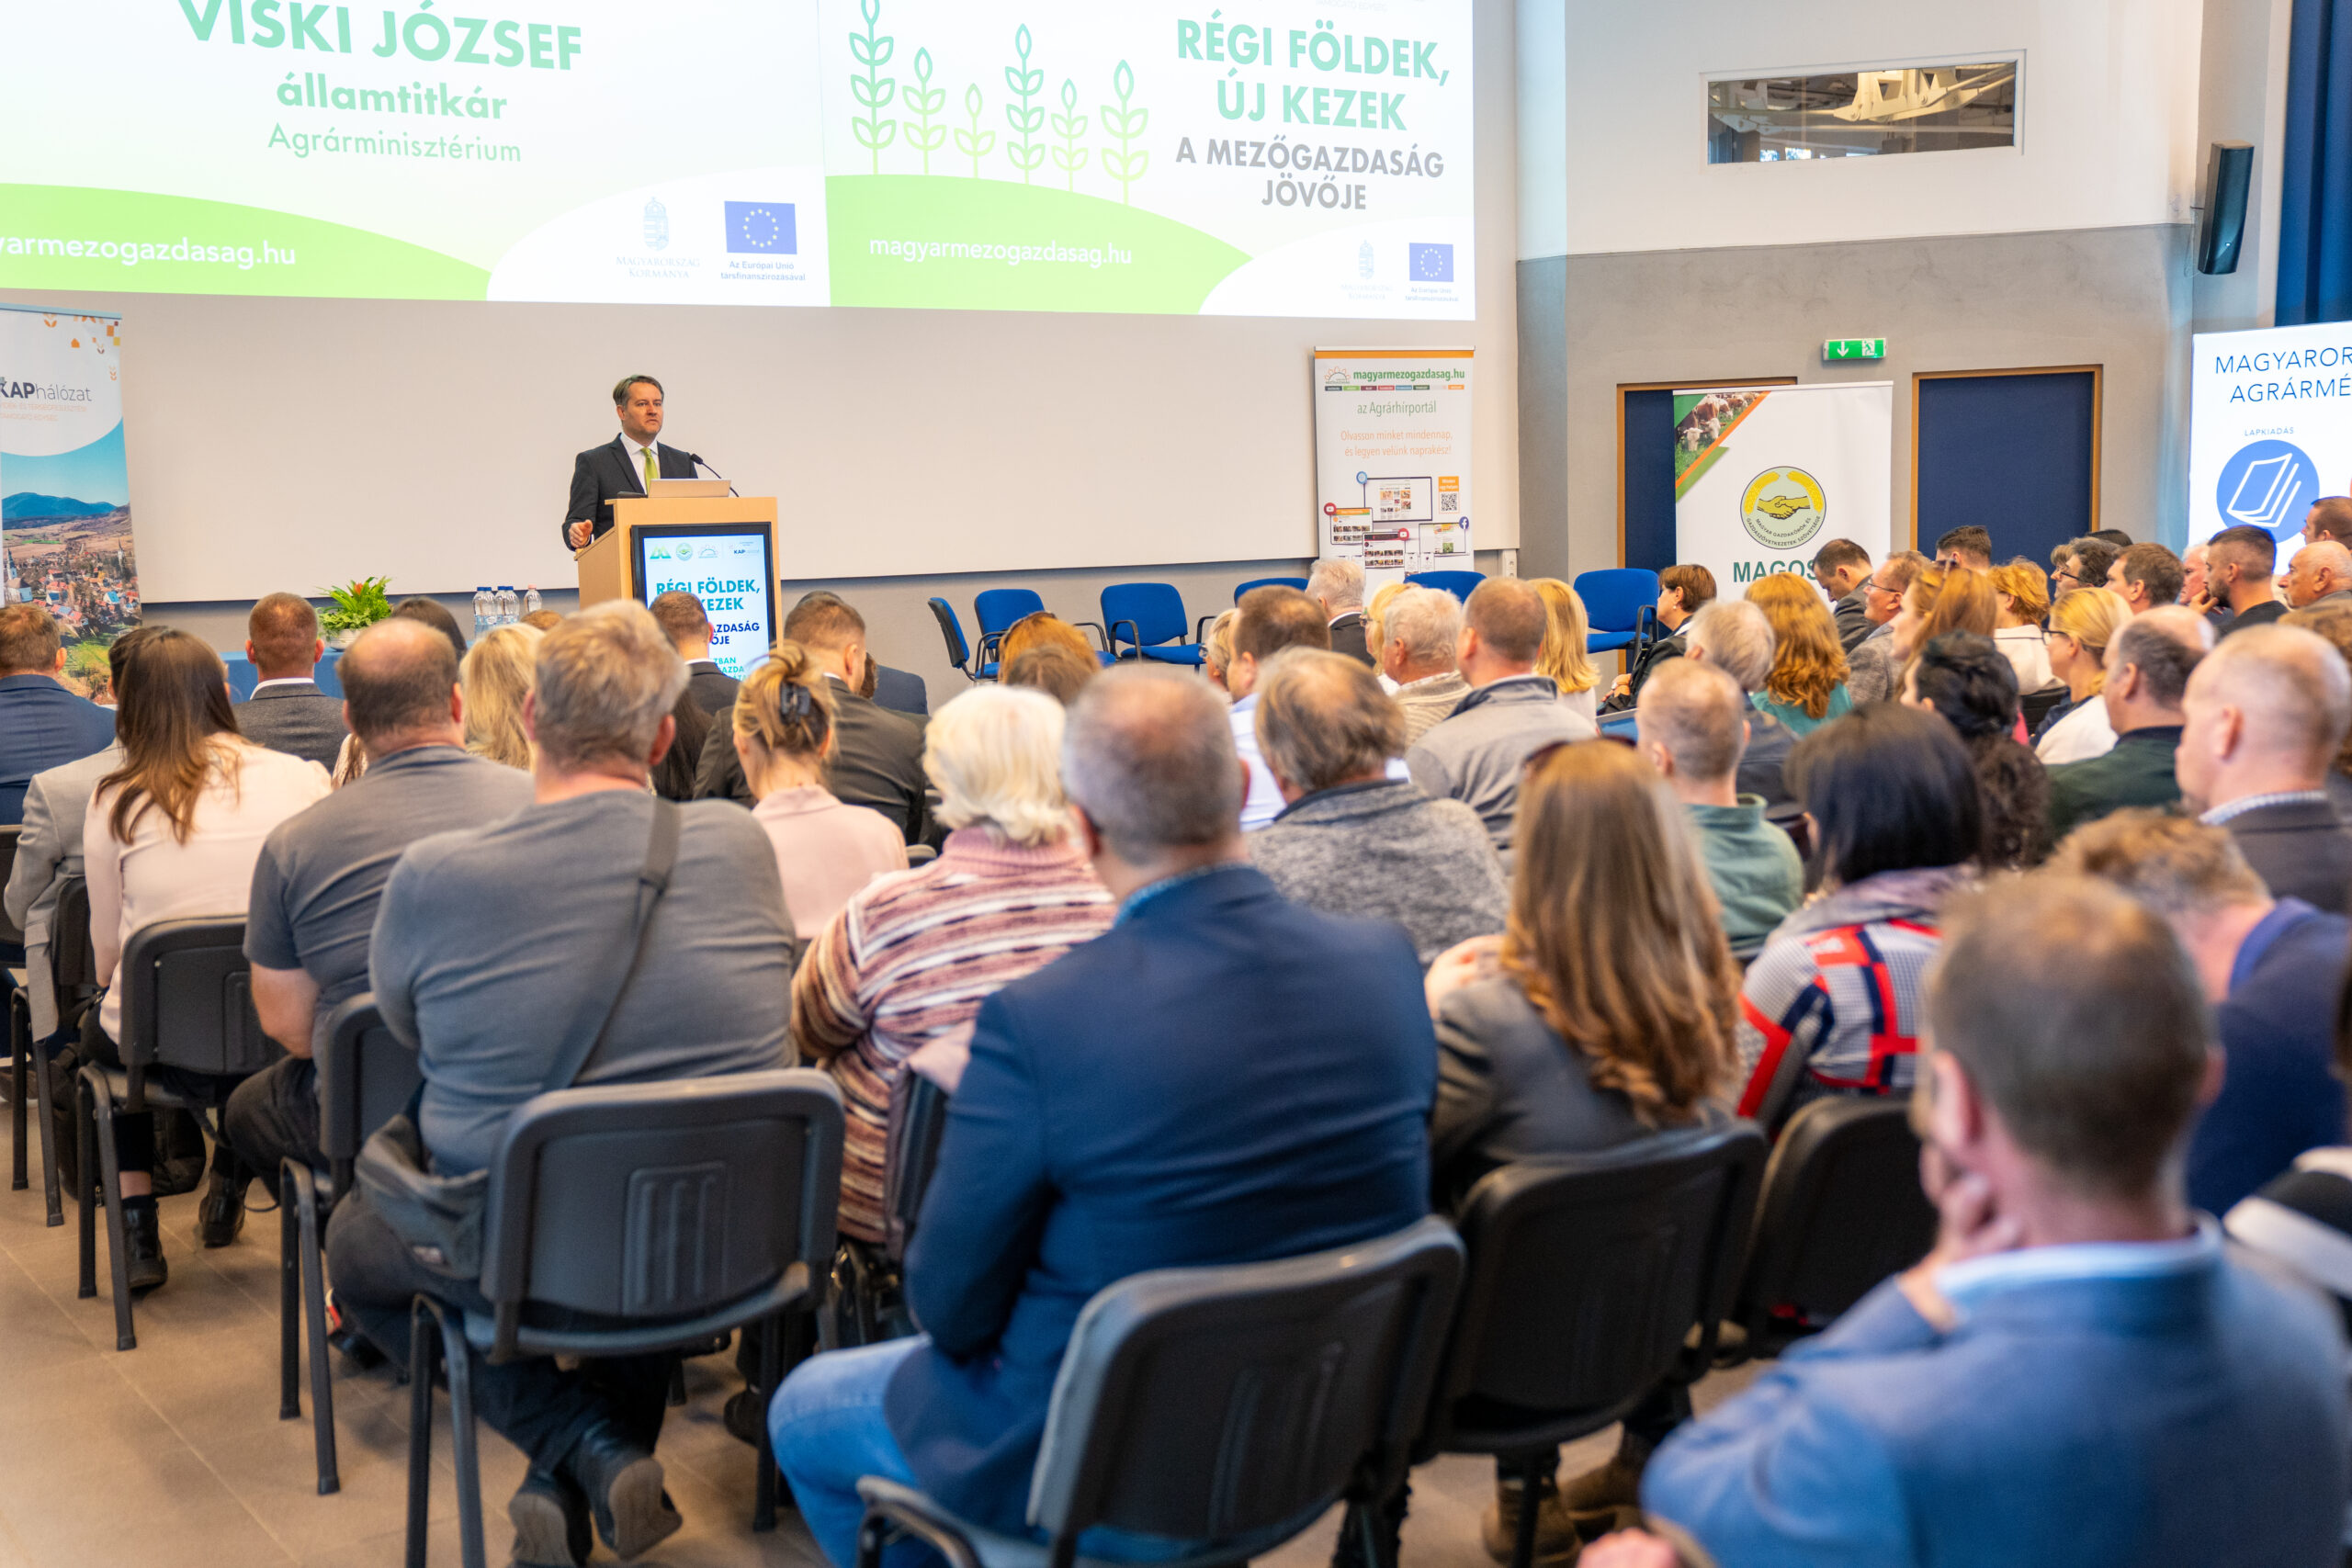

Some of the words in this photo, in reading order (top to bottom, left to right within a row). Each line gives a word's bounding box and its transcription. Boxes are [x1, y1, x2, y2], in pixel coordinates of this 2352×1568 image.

[180, 0, 353, 54] VISKI
[372, 0, 582, 71] JÓZSEF
[1177, 9, 1272, 66] RÉGI
[1289, 20, 1451, 86] FÖLDEK,
[277, 72, 507, 119] államtitkár
[1217, 67, 1266, 122] ÚJ
[1283, 80, 1408, 131] KEZEK
[267, 123, 522, 163] Agrárminisztérium
[1175, 137, 1197, 165] A
[1206, 134, 1445, 178] MEZŐGAZDASÁG
[1261, 173, 1367, 211] JÖVŐJE
[869, 235, 1132, 268] magyarmezogazdasag.hu
[729, 261, 740, 269] Az
[1352, 368, 1465, 382] magyarmezogazdasag.hu
[2230, 373, 2351, 403] AGRÁRMÉ
[1357, 404, 1367, 414] az
[1369, 400, 1437, 417] Agrárhírportál
[1340, 430, 1374, 441] Olvasson
[1377, 429, 1404, 441] minket
[2244, 427, 2294, 436] LAPKIADÁS
[1355, 445, 1381, 458] legyen
[1756, 518, 1772, 535] MAGYAR
[697, 577, 761, 594] FÖLDEK,
[713, 621, 760, 633] ZDASÁG
